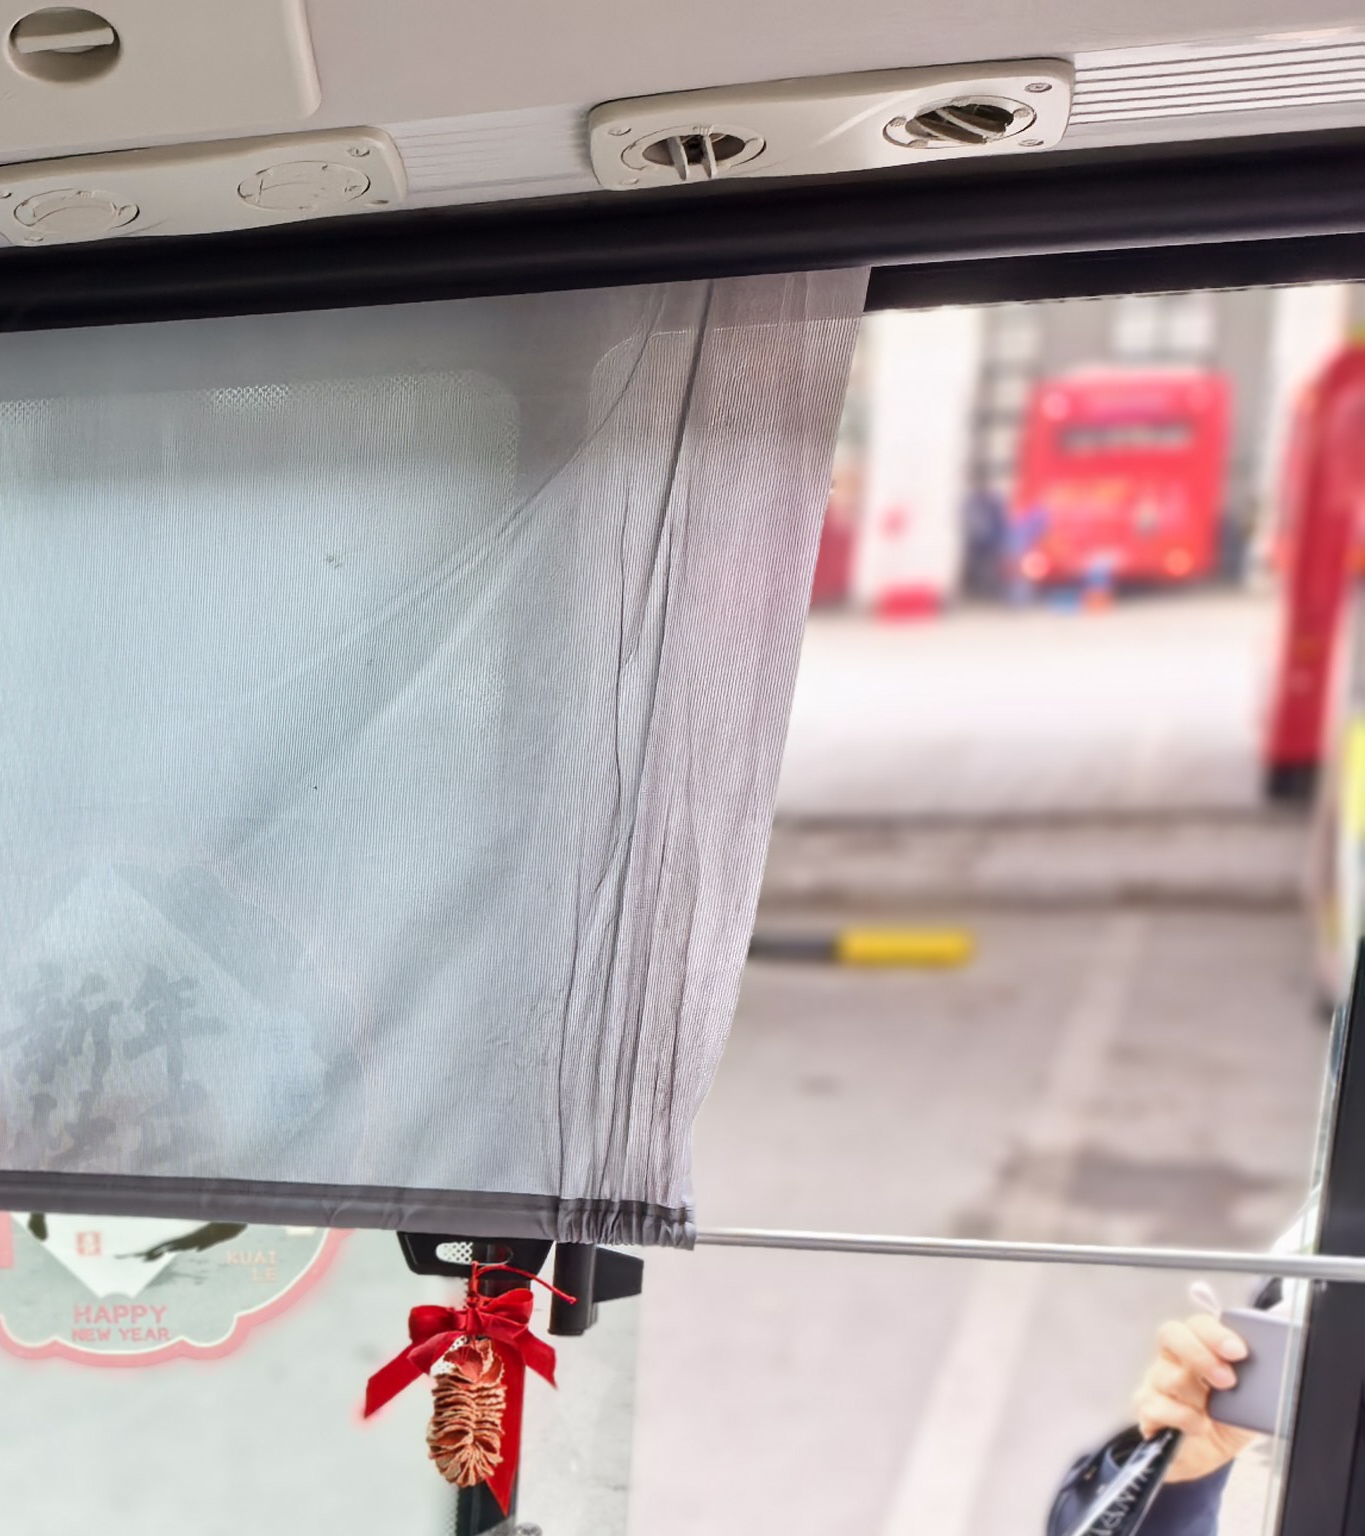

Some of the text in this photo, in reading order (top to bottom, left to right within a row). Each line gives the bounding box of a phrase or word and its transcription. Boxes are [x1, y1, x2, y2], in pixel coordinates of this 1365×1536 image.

[252, 1267, 278, 1283] LE
[73, 1304, 168, 1325] HAPPY
[71, 1327, 170, 1343] NEW YEAR
